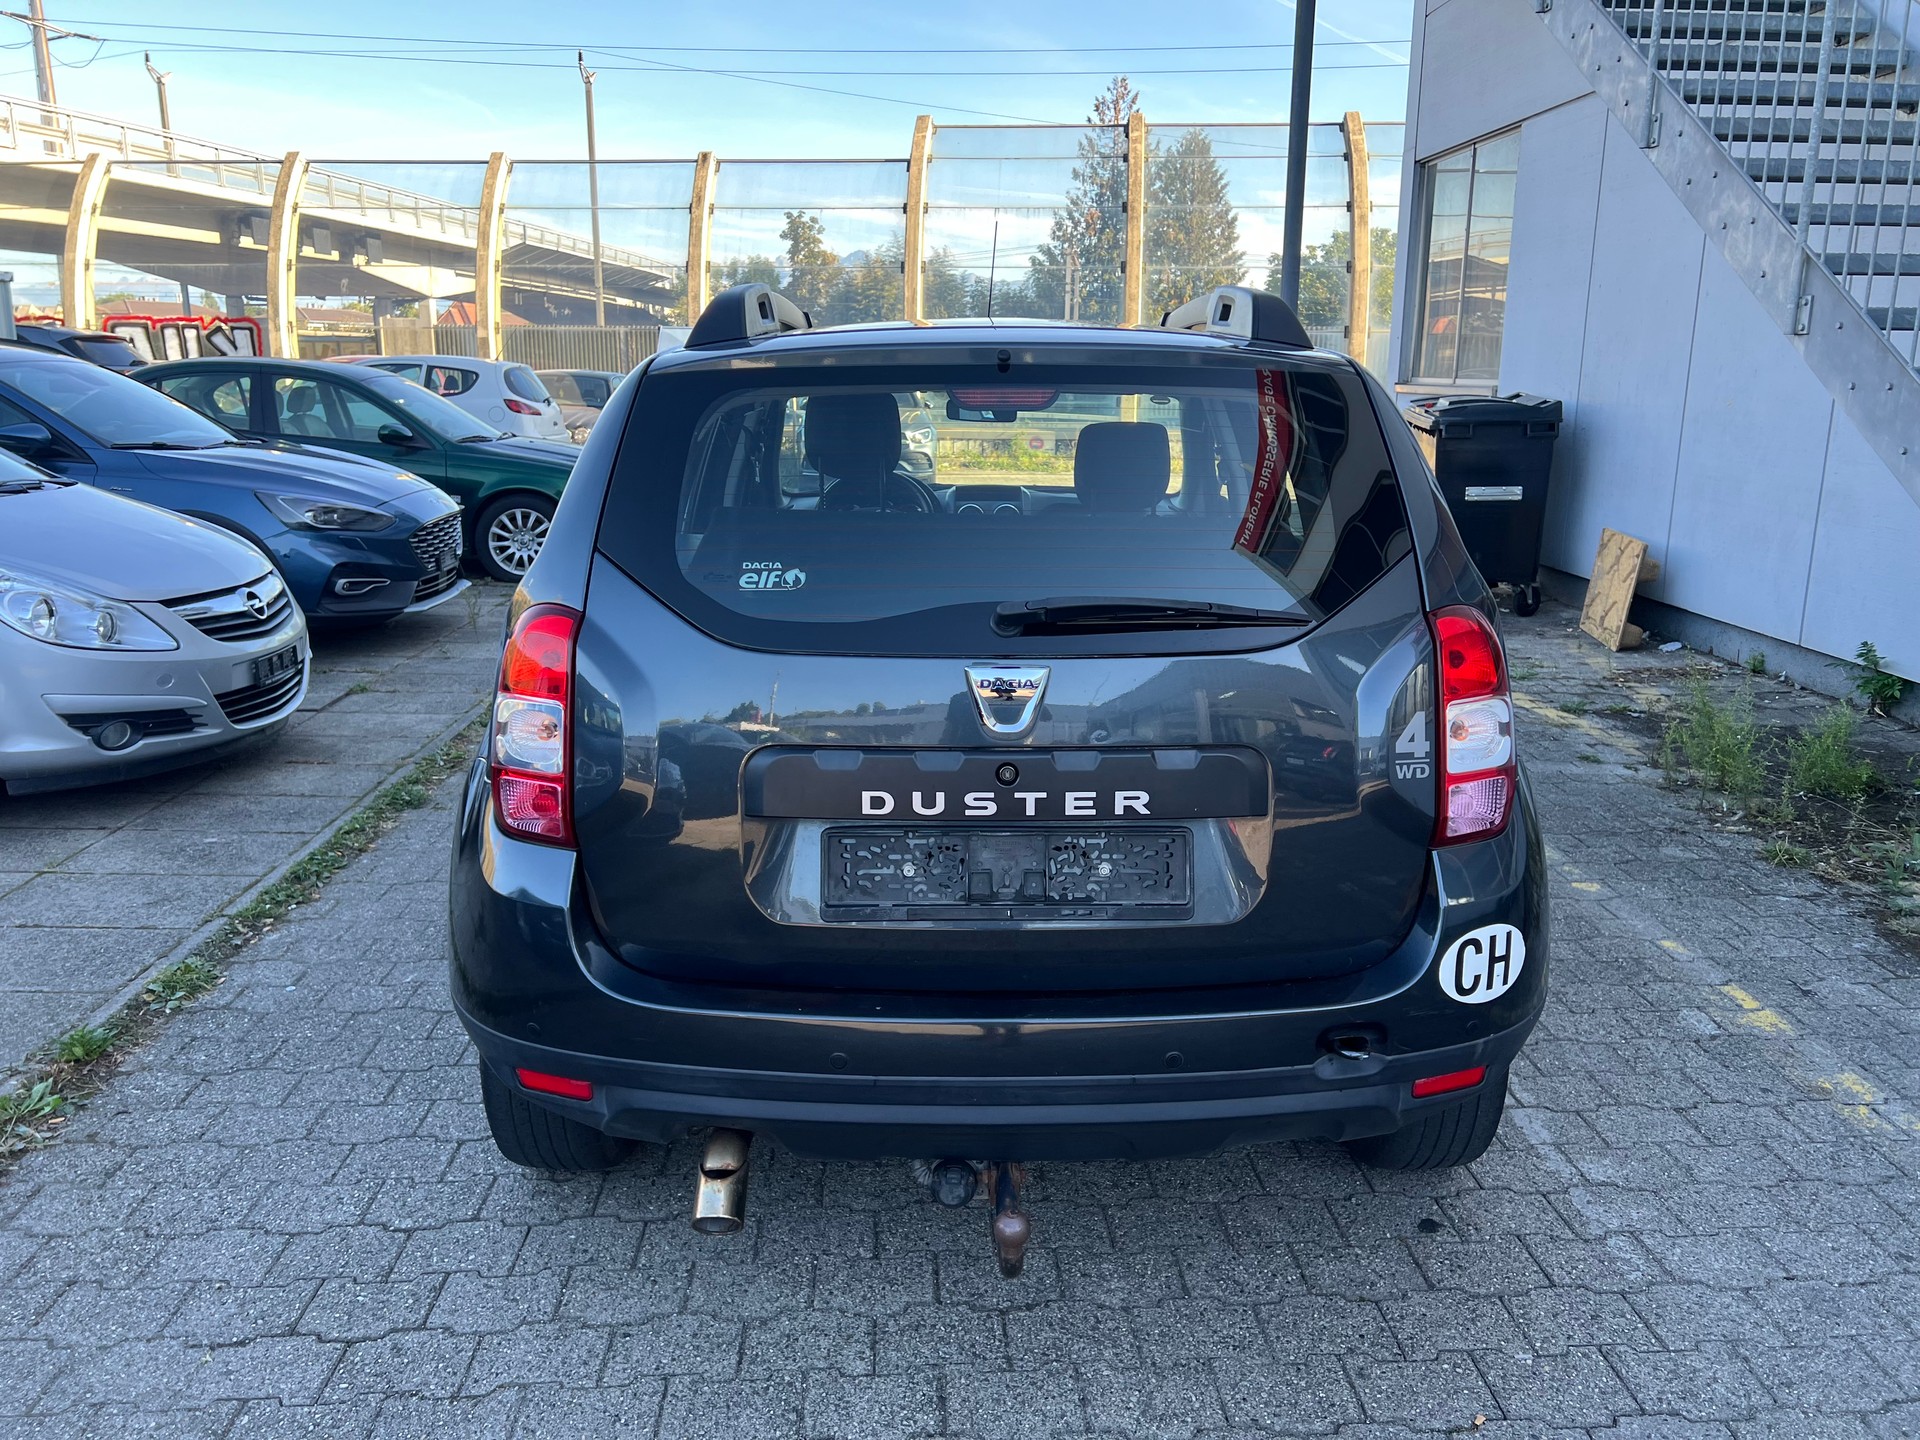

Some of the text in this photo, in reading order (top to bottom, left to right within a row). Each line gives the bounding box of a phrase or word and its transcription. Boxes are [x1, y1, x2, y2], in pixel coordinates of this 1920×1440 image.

[739, 571, 782, 588] elf
[980, 679, 1035, 689] DACIA
[1395, 711, 1430, 758] 4
[1395, 764, 1430, 779] WD
[861, 790, 1151, 816] DUSTER
[1454, 930, 1512, 996] CH
